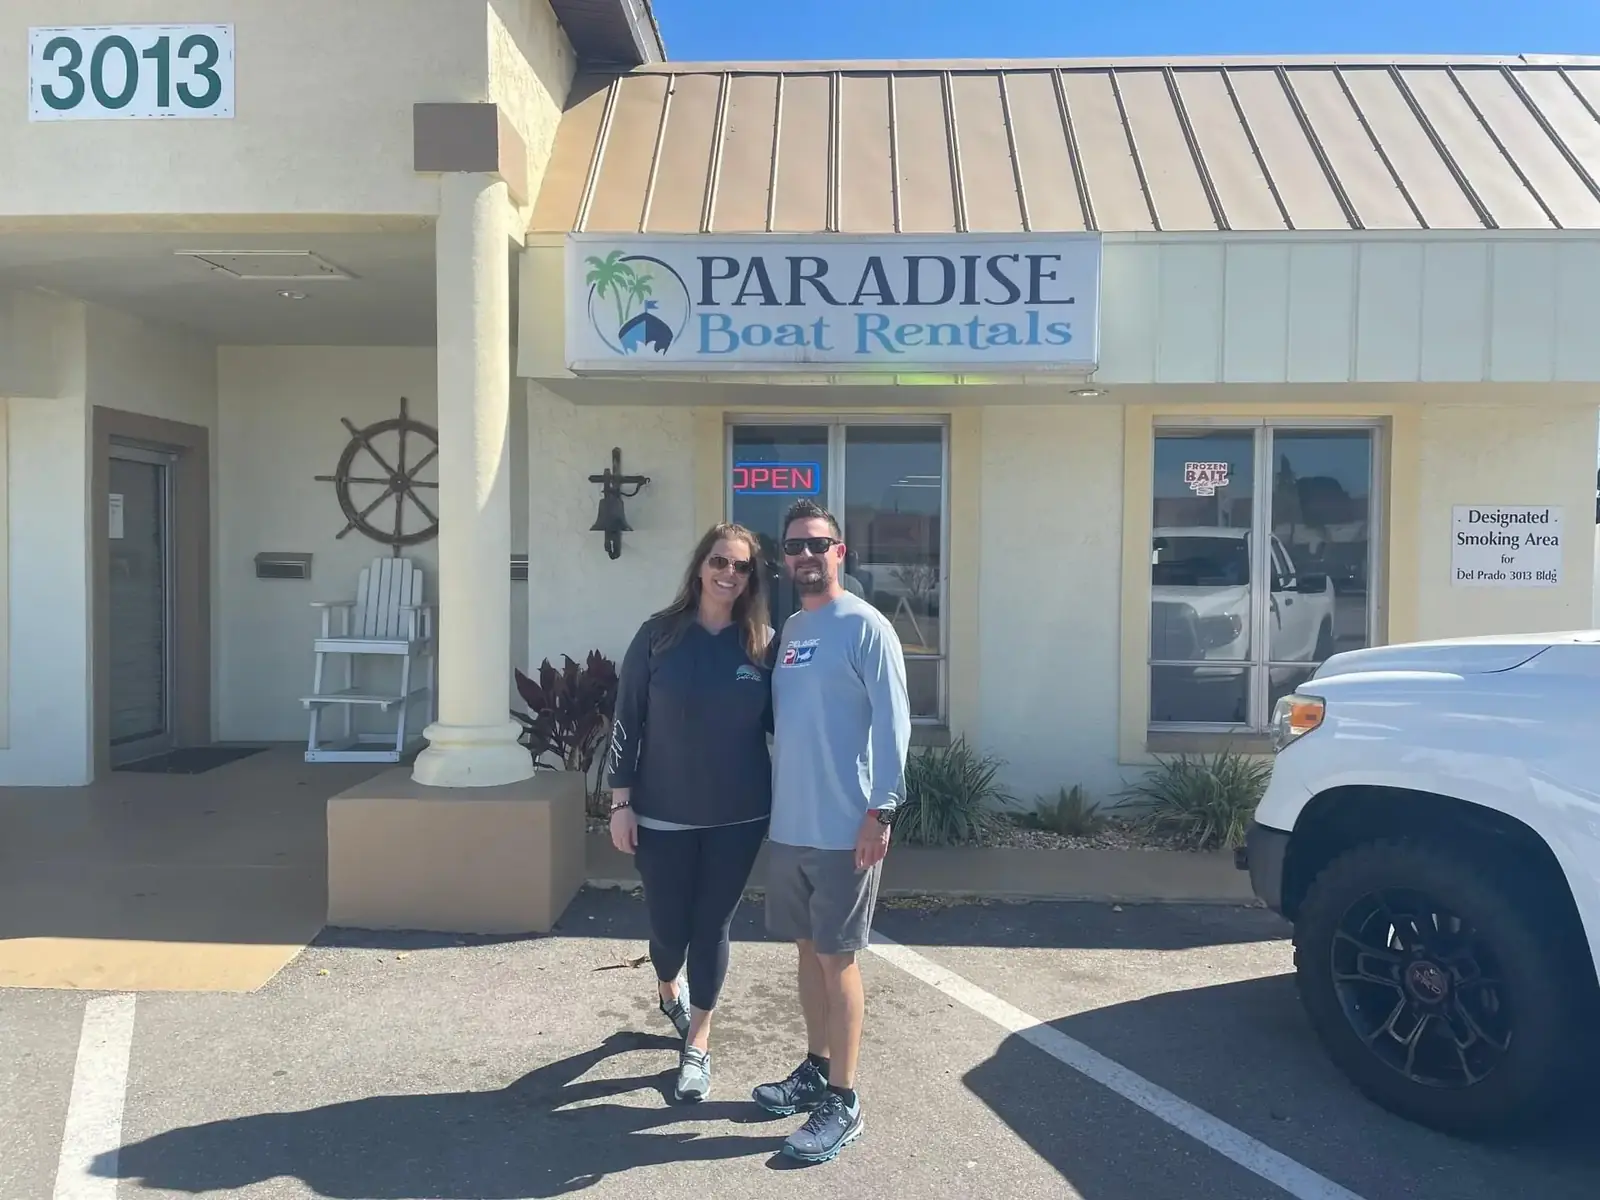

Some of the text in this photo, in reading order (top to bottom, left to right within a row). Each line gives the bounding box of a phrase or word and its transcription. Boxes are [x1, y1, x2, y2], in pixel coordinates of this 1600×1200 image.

[41, 34, 221, 110] 3013
[696, 254, 1075, 307] PARADISE
[696, 311, 1072, 355] Boat Rentals
[733, 468, 812, 489] OPEN
[1186, 470, 1226, 481] BAIT
[1468, 509, 1549, 528] Designated
[1457, 531, 1559, 550] Smoking Area
[1500, 554, 1515, 564] for
[1457, 570, 1557, 583] Del Prado 3013 Bldg
